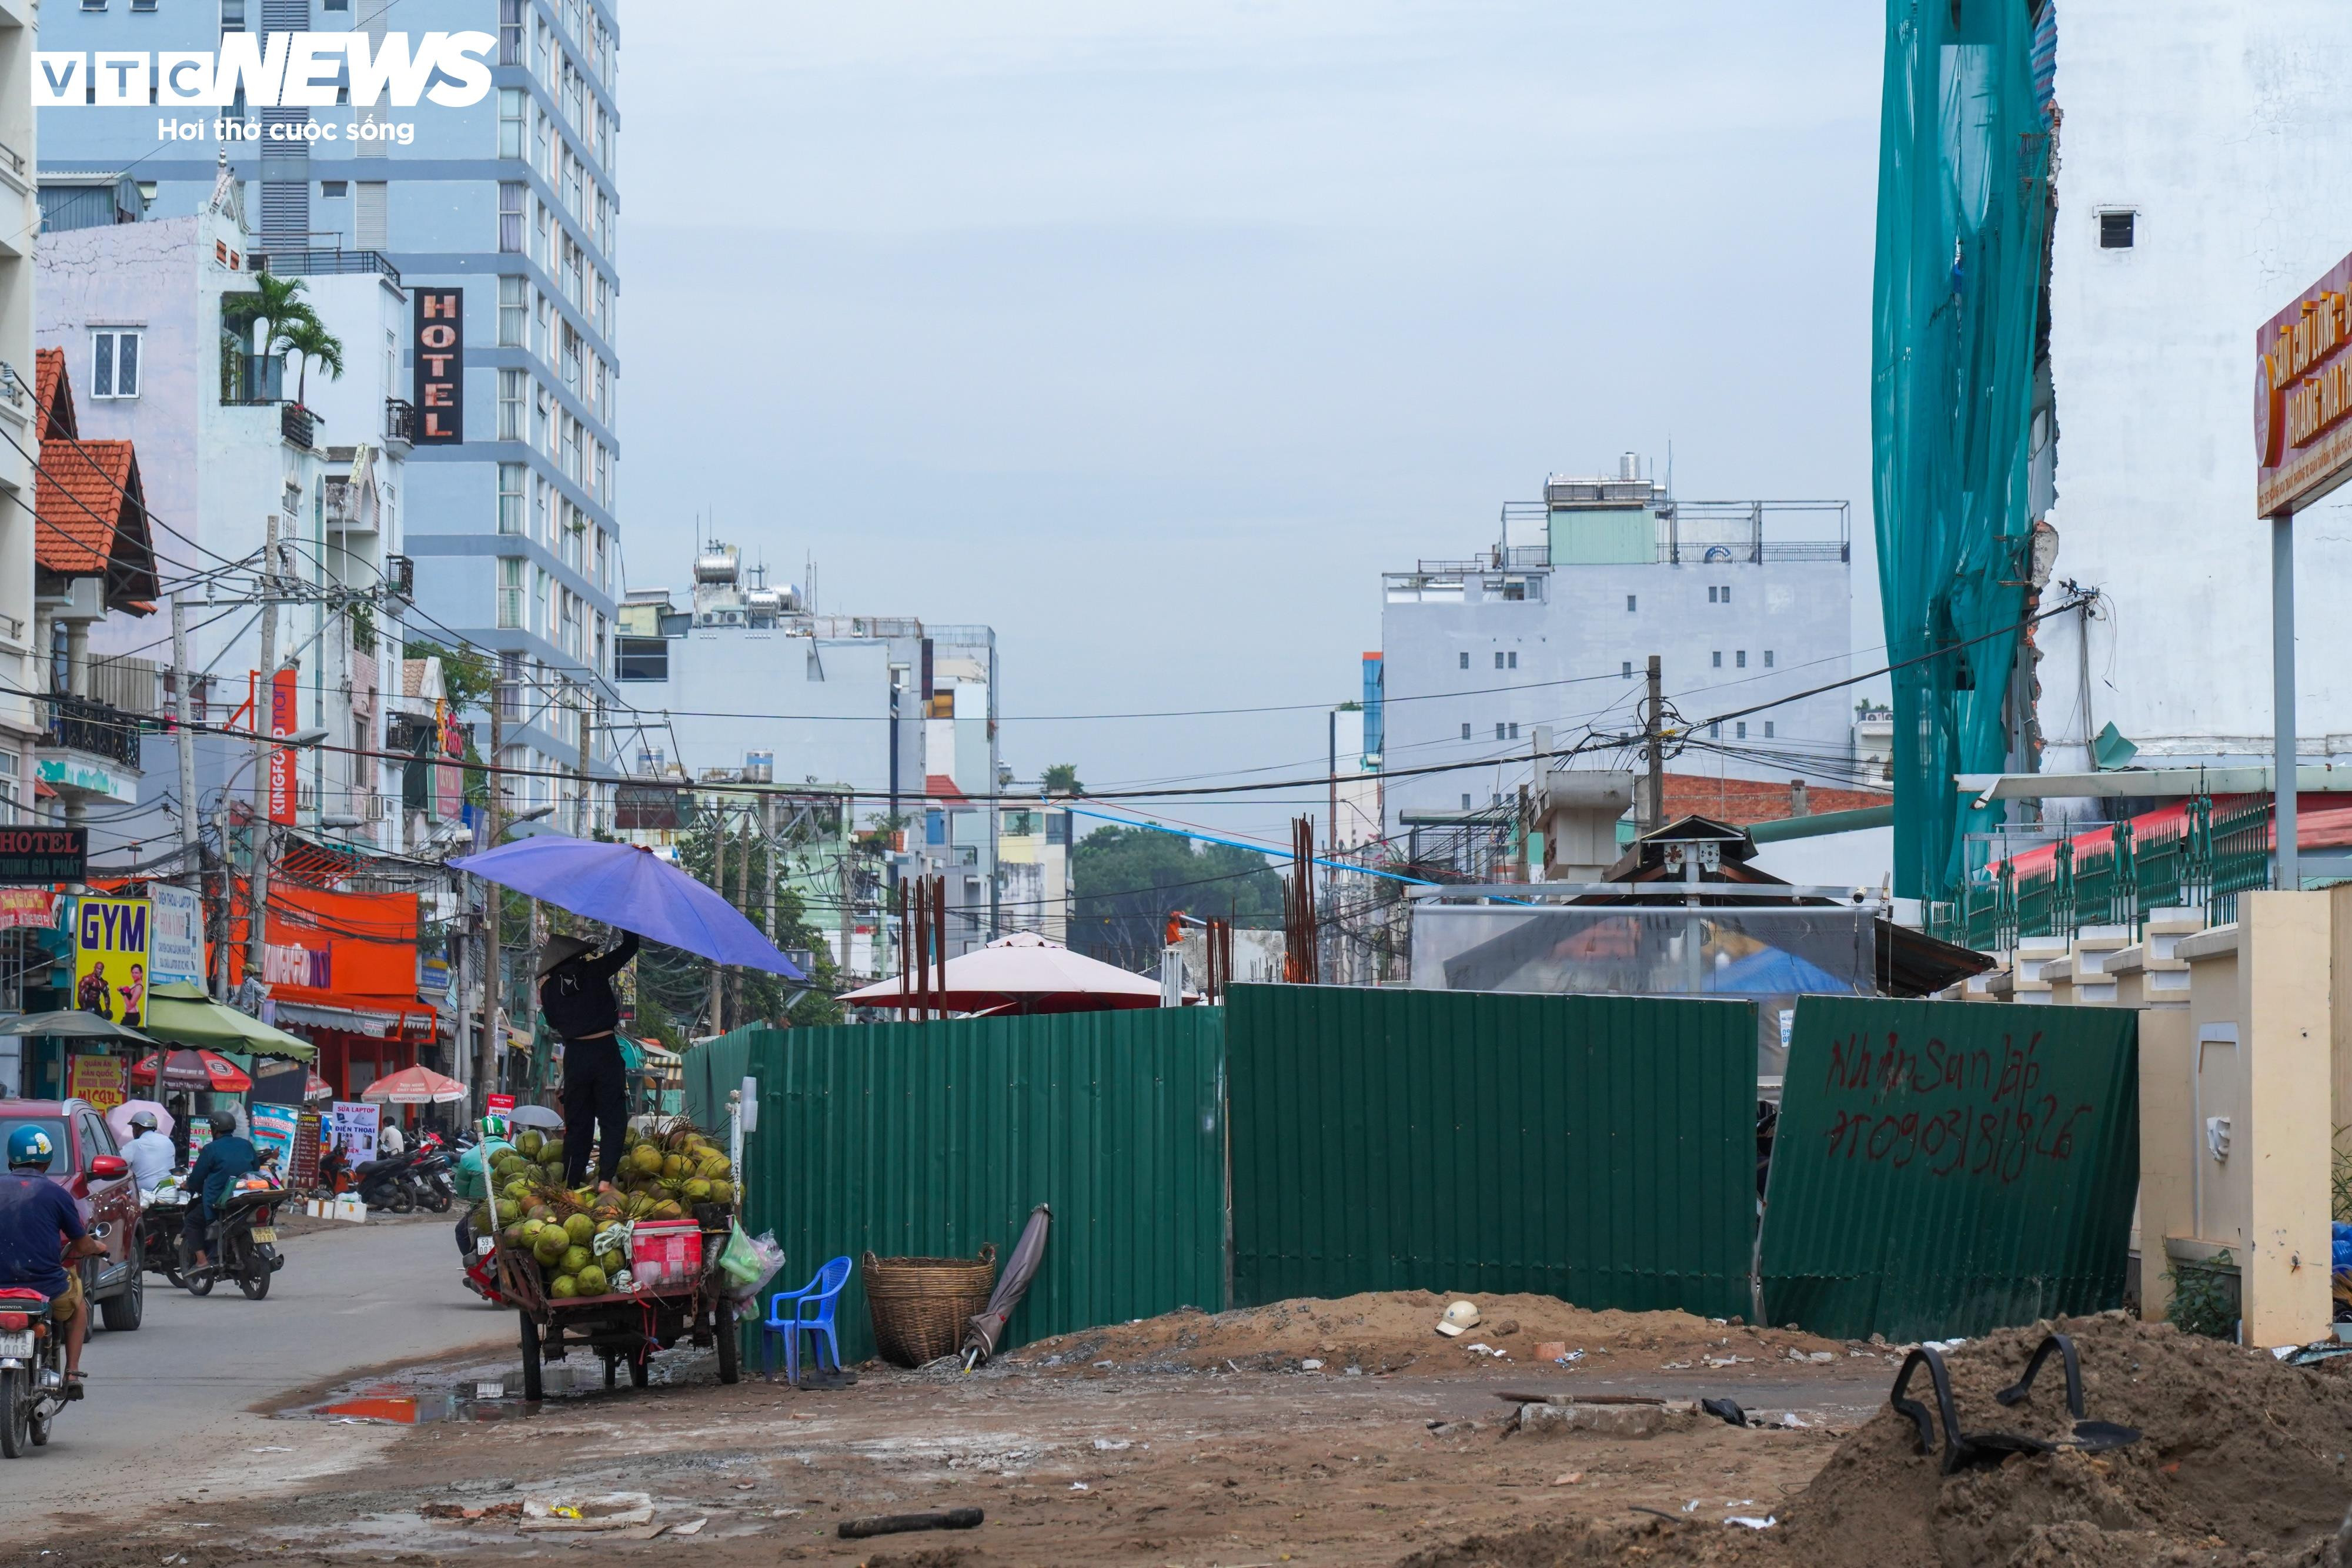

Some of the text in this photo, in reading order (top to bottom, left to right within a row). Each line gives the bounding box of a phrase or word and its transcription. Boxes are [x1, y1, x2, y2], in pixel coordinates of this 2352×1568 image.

[421, 295, 456, 436] HOTEL
[0, 831, 79, 852] HOTEL
[32, 859, 49, 875] GIA
[53, 856, 81, 875] PHÁT
[81, 903, 146, 952] GYM
